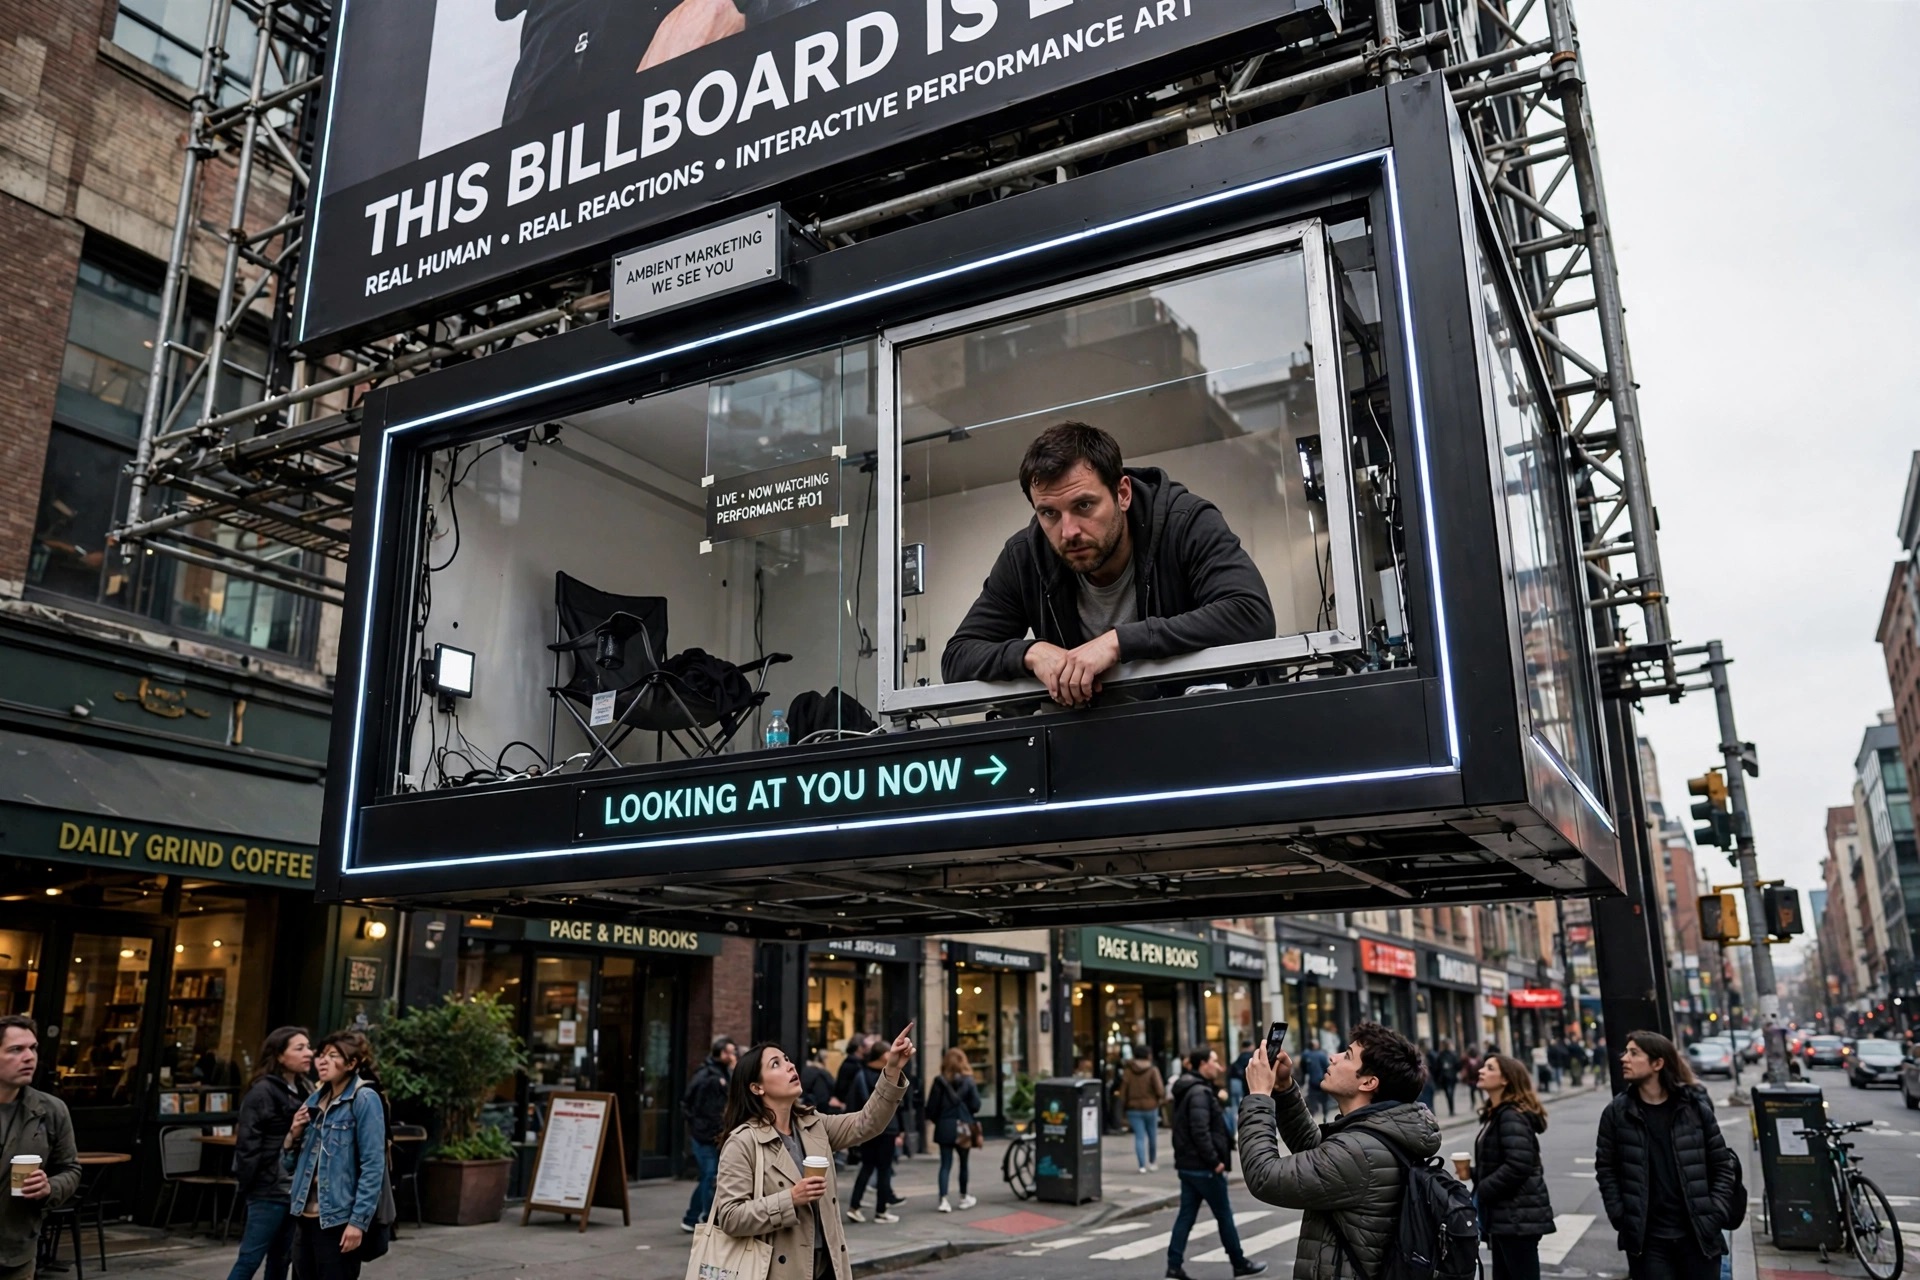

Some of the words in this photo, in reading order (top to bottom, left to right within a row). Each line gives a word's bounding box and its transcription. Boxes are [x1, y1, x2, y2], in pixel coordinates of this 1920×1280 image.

[364, 161, 491, 257] THIS
[506, 10, 900, 207] BILLBOARD
[926, 0, 999, 55] IS
[365, 264, 413, 297] REAL
[418, 235, 492, 279] HUMAN
[518, 209, 572, 244] REAL
[578, 160, 705, 223] REACTIONS
[735, 91, 899, 169] INTERACTIVE
[906, 15, 1125, 110] PERFORMANCE
[626, 255, 682, 285] AMBIENT
[685, 230, 762, 267] MARKETING
[651, 277, 673, 296] WE
[676, 268, 701, 288] SEE
[705, 258, 734, 278] YOU
[716, 491, 738, 508] LIVE
[748, 483, 773, 501] NOW
[774, 472, 830, 495] WATCHING
[716, 496, 795, 525] PERFORMANCE
[797, 490, 823, 509] #01
[605, 783, 737, 825] LOOKING
[747, 777, 787, 811] AT
[796, 768, 865, 805] YOU
[878, 757, 962, 797] NOW
[59, 822, 139, 858] DAILY
[146, 834, 223, 868] GRIND
[231, 845, 314, 879] COFFEE
[550, 919, 592, 941] PAGE
[597, 923, 609, 943] &
[613, 924, 644, 946] PEN
[649, 928, 699, 950] BOOKS
[1097, 935, 1129, 961] PAGE
[1130, 941, 1140, 962] &
[1141, 942, 1164, 964] PEN
[1165, 946, 1199, 969] BOOKS
